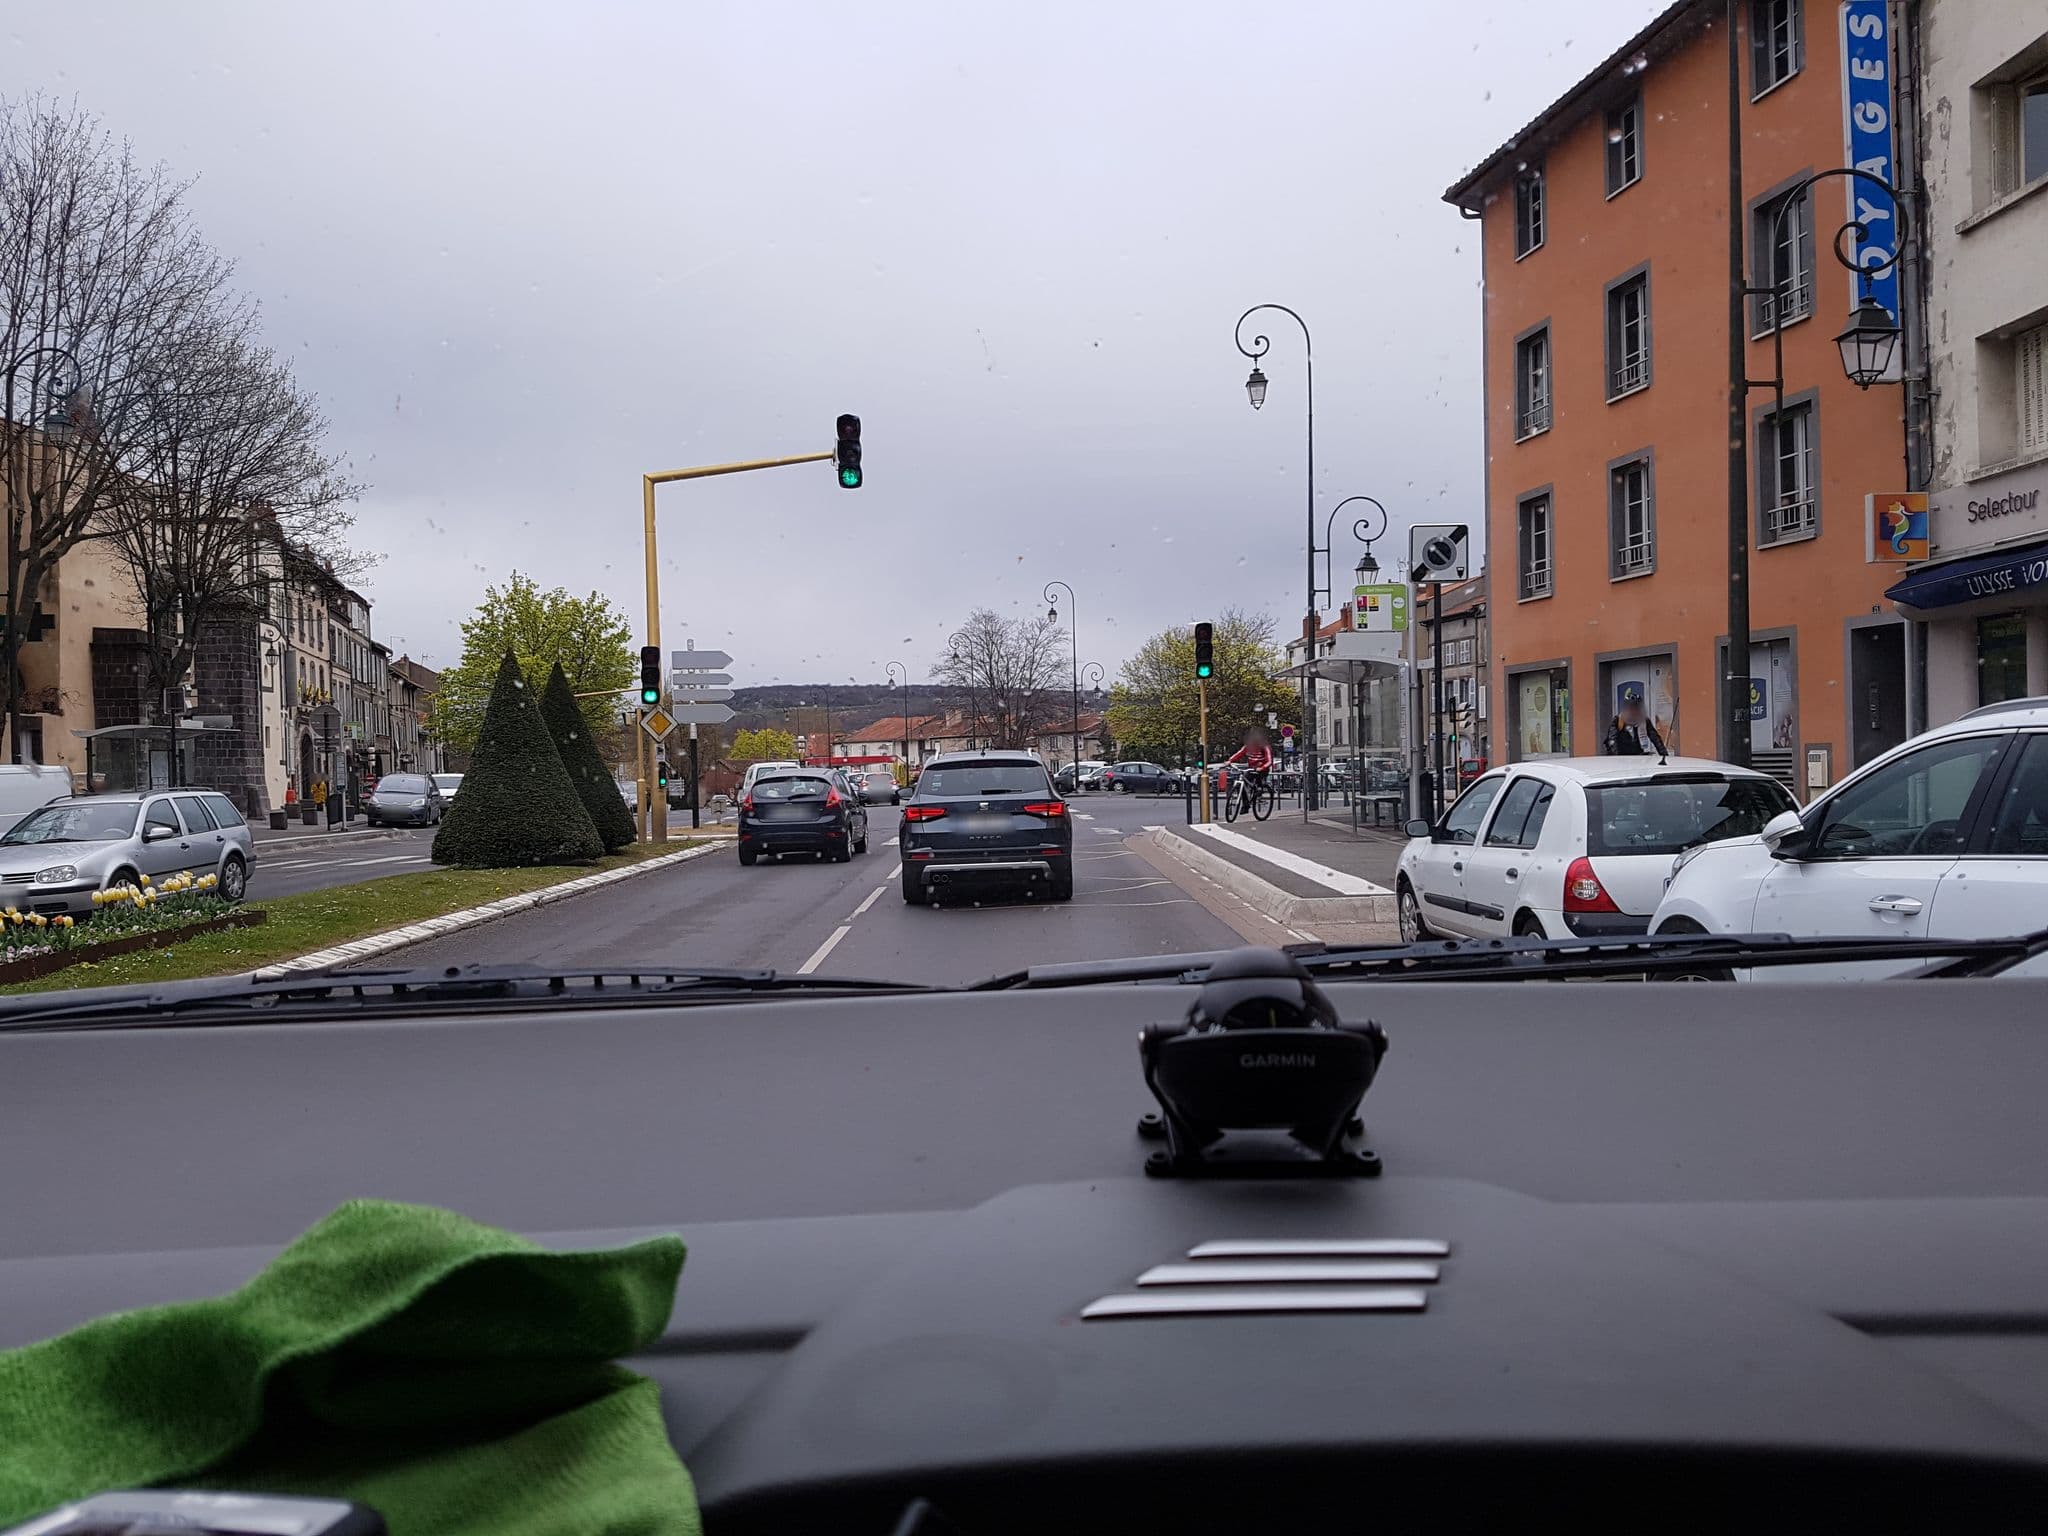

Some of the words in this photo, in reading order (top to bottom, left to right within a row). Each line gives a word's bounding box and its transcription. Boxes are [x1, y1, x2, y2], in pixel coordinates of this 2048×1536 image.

[1849, 13, 1894, 320] OYAGES
[1967, 489, 2040, 523] Selectour
[1967, 569, 2015, 596] ULYSSE
[1240, 1053, 1316, 1068] GARMIN
